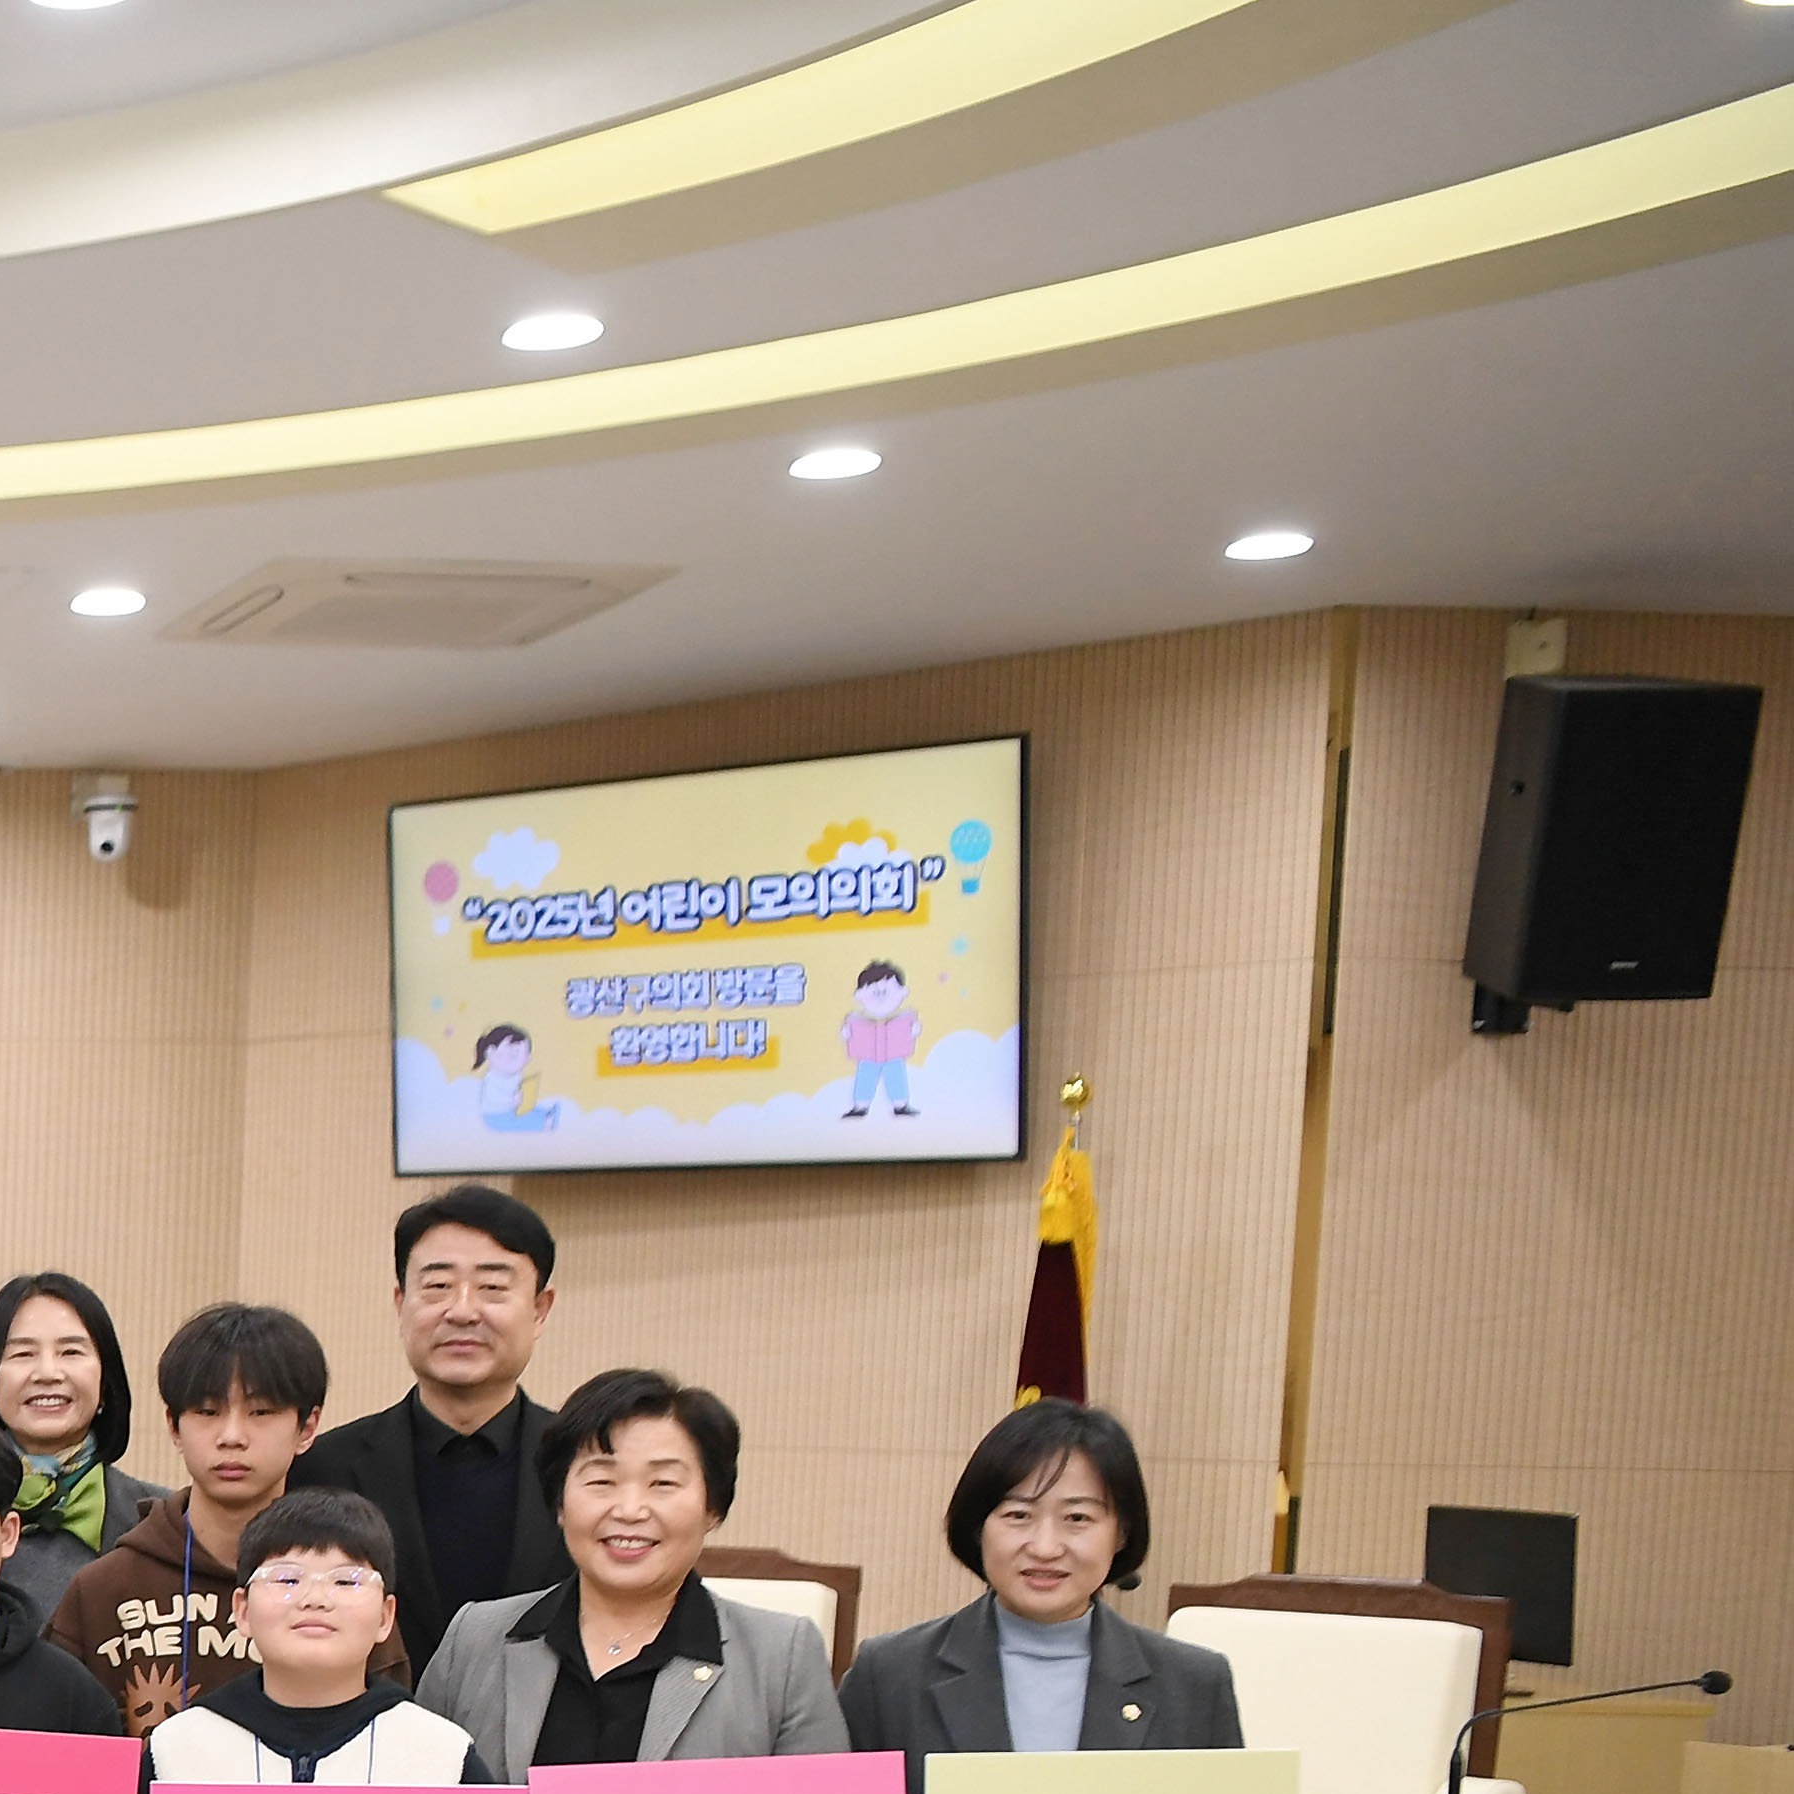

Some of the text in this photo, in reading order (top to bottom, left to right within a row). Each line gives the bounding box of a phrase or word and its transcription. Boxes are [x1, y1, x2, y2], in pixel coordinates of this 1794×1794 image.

[619, 876, 741, 933] 어린이
[567, 963, 807, 1018] 광산구의회 방문을
[610, 1018, 767, 1066] 환영합니다!
[117, 1593, 218, 1630] SUN
[97, 1626, 183, 1668] THE
